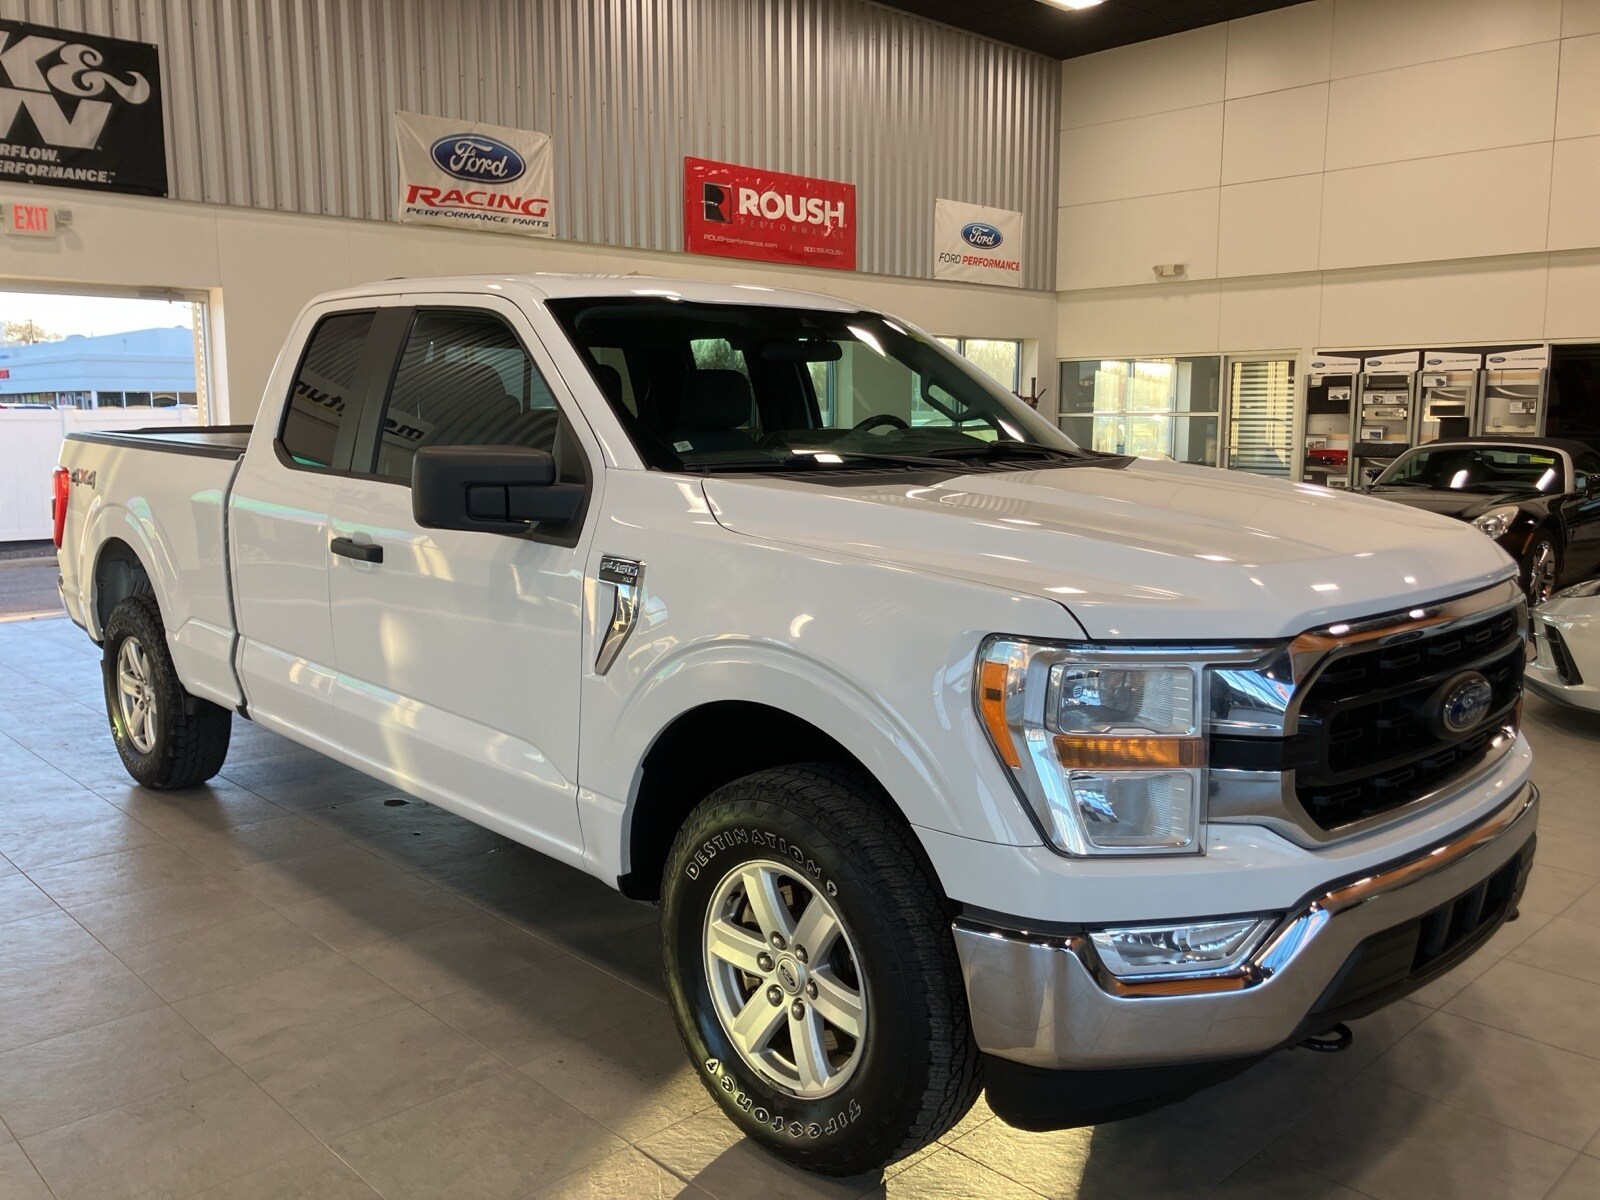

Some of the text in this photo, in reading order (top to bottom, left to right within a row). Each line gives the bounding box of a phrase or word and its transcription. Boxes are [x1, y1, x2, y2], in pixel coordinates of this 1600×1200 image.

[0, 143, 60, 163] RFLOW.
[450, 141, 508, 177] Ford
[0, 160, 112, 183] RFORMANCE.
[406, 184, 549, 217] RACING
[738, 188, 845, 228] ROUSH
[14, 205, 48, 231] EXIT
[406, 207, 549, 228] PERFORMANCE PARTS
[969, 226, 996, 246] Ford
[938, 252, 1020, 271] FORD PERFORMANCE
[685, 828, 822, 881] DESTINATION
[721, 1075, 861, 1139] Firestone
